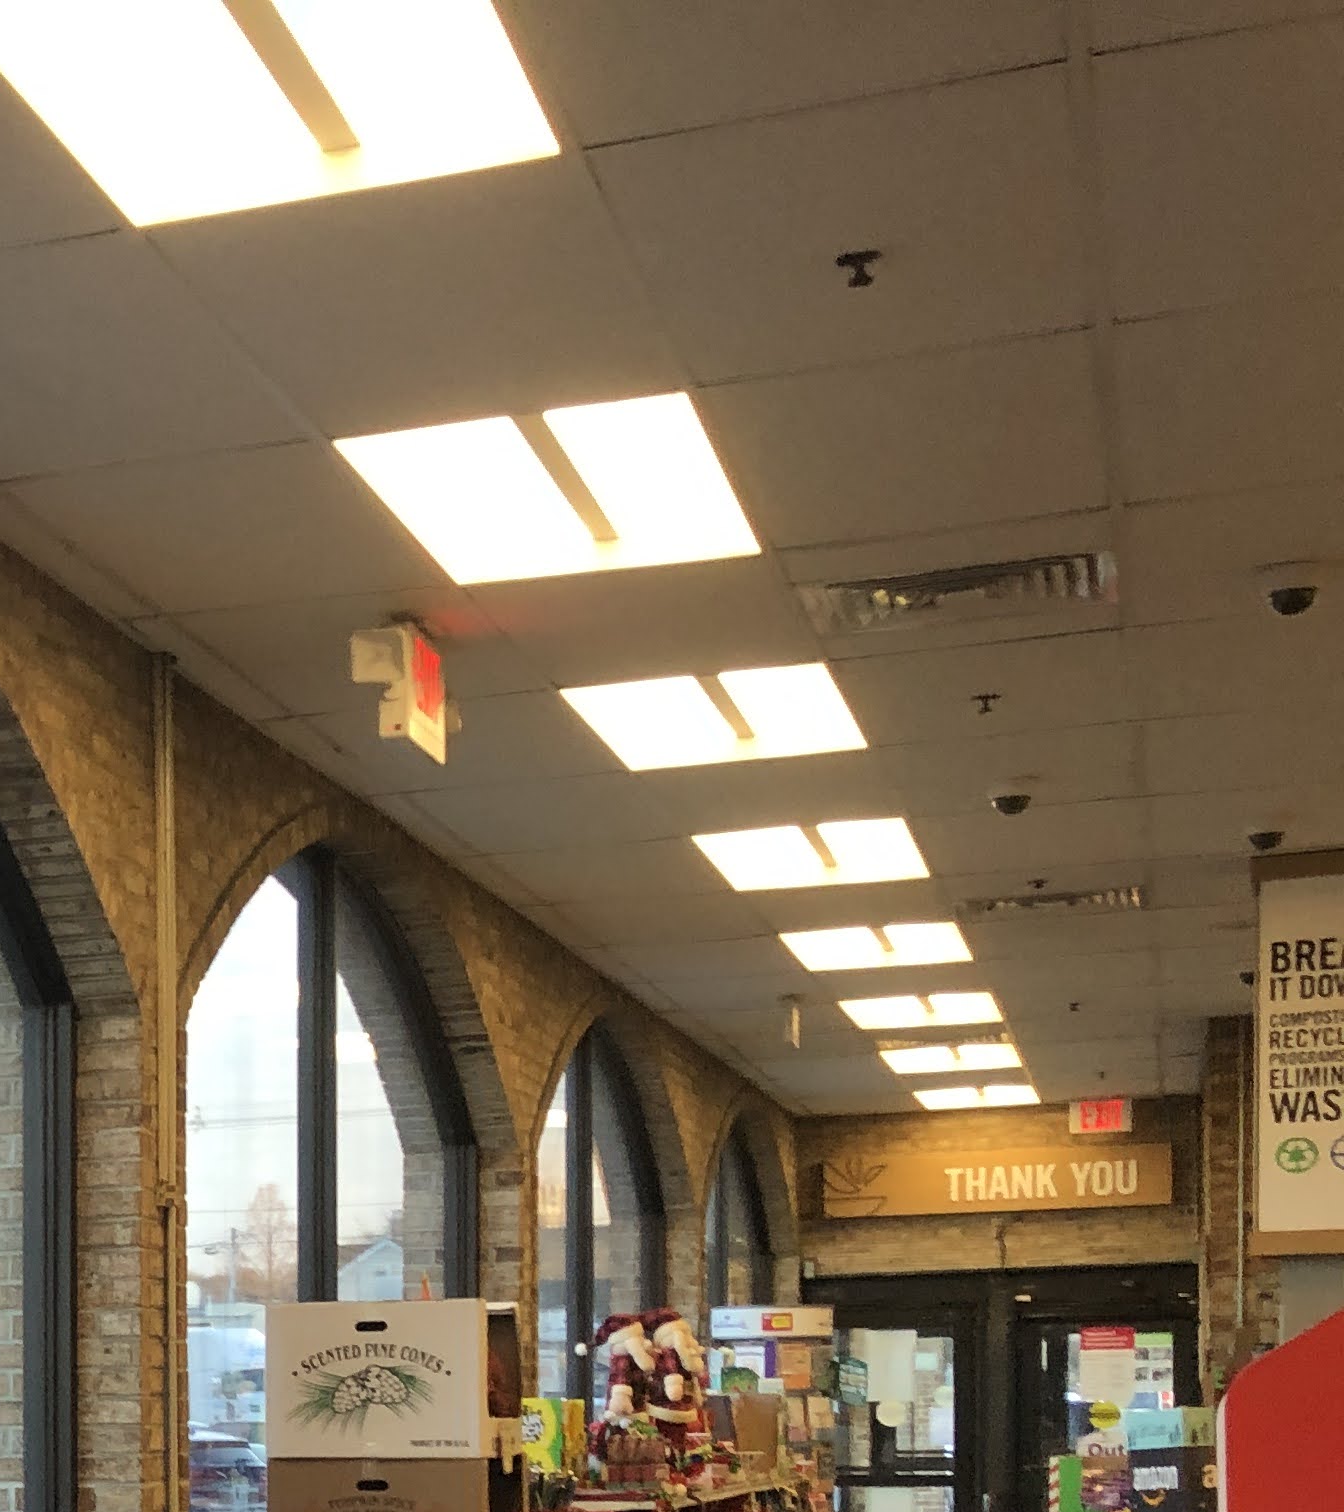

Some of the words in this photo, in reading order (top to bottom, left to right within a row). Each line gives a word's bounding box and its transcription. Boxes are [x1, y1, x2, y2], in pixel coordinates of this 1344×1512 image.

[1270, 937, 1344, 973] BRE
[1269, 976, 1292, 1001] IT
[944, 1163, 1058, 1202] THANK
[1070, 1159, 1138, 1197] YOU
[300, 1344, 362, 1375] SCENTED
[365, 1343, 398, 1358] PINE
[400, 1345, 445, 1374] CONES
